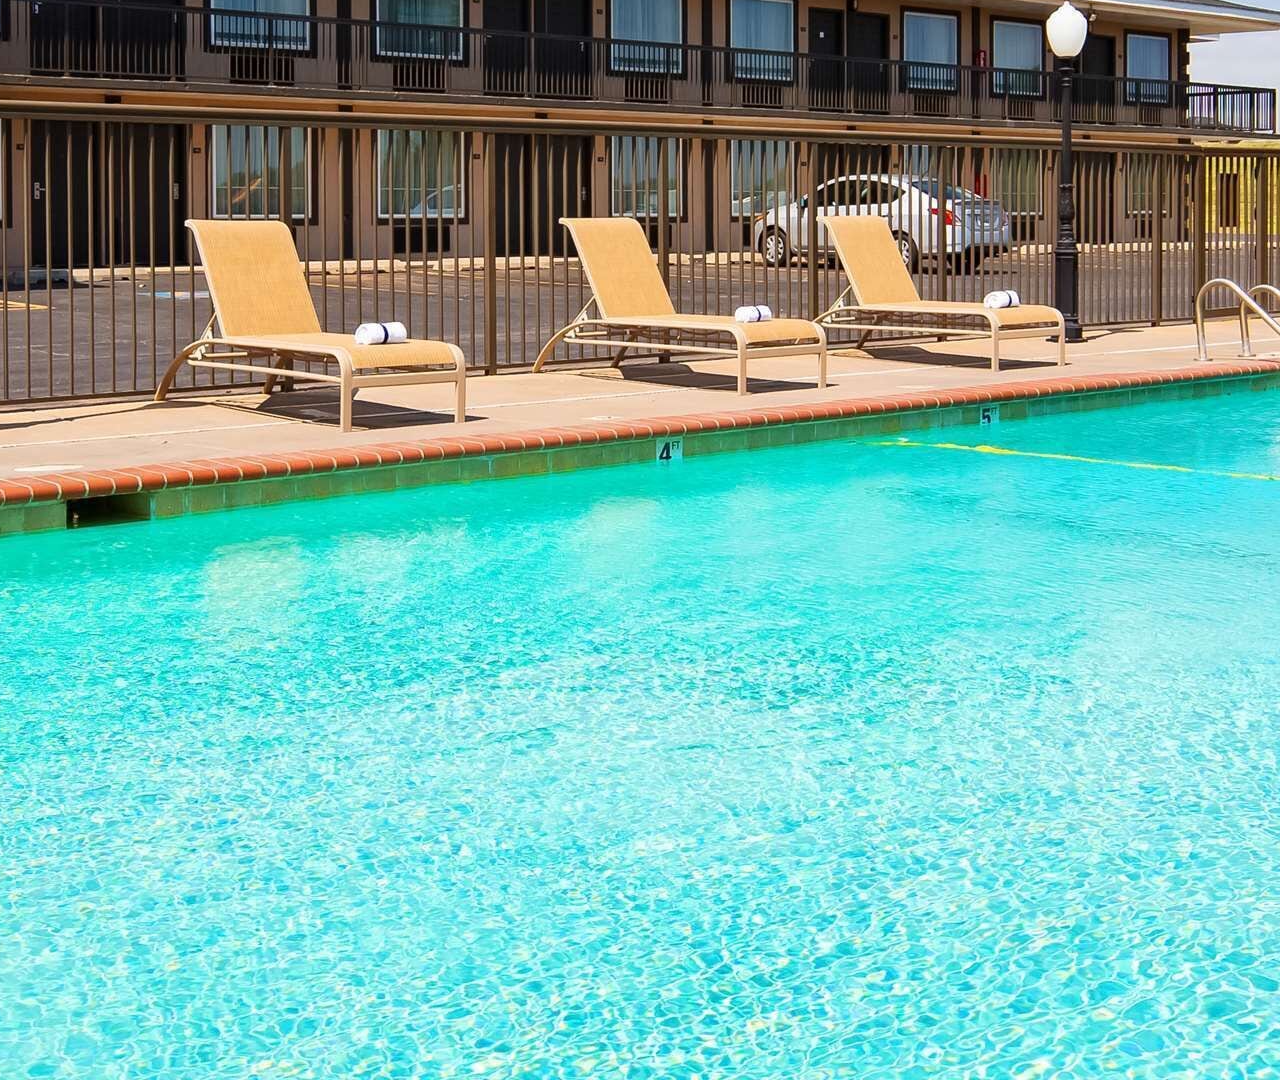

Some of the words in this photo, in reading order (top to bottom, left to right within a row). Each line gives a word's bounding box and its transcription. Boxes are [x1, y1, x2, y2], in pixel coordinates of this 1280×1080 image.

[982, 407, 991, 424] 5
[659, 441, 672, 460] 4
[672, 440, 681, 450] FT
